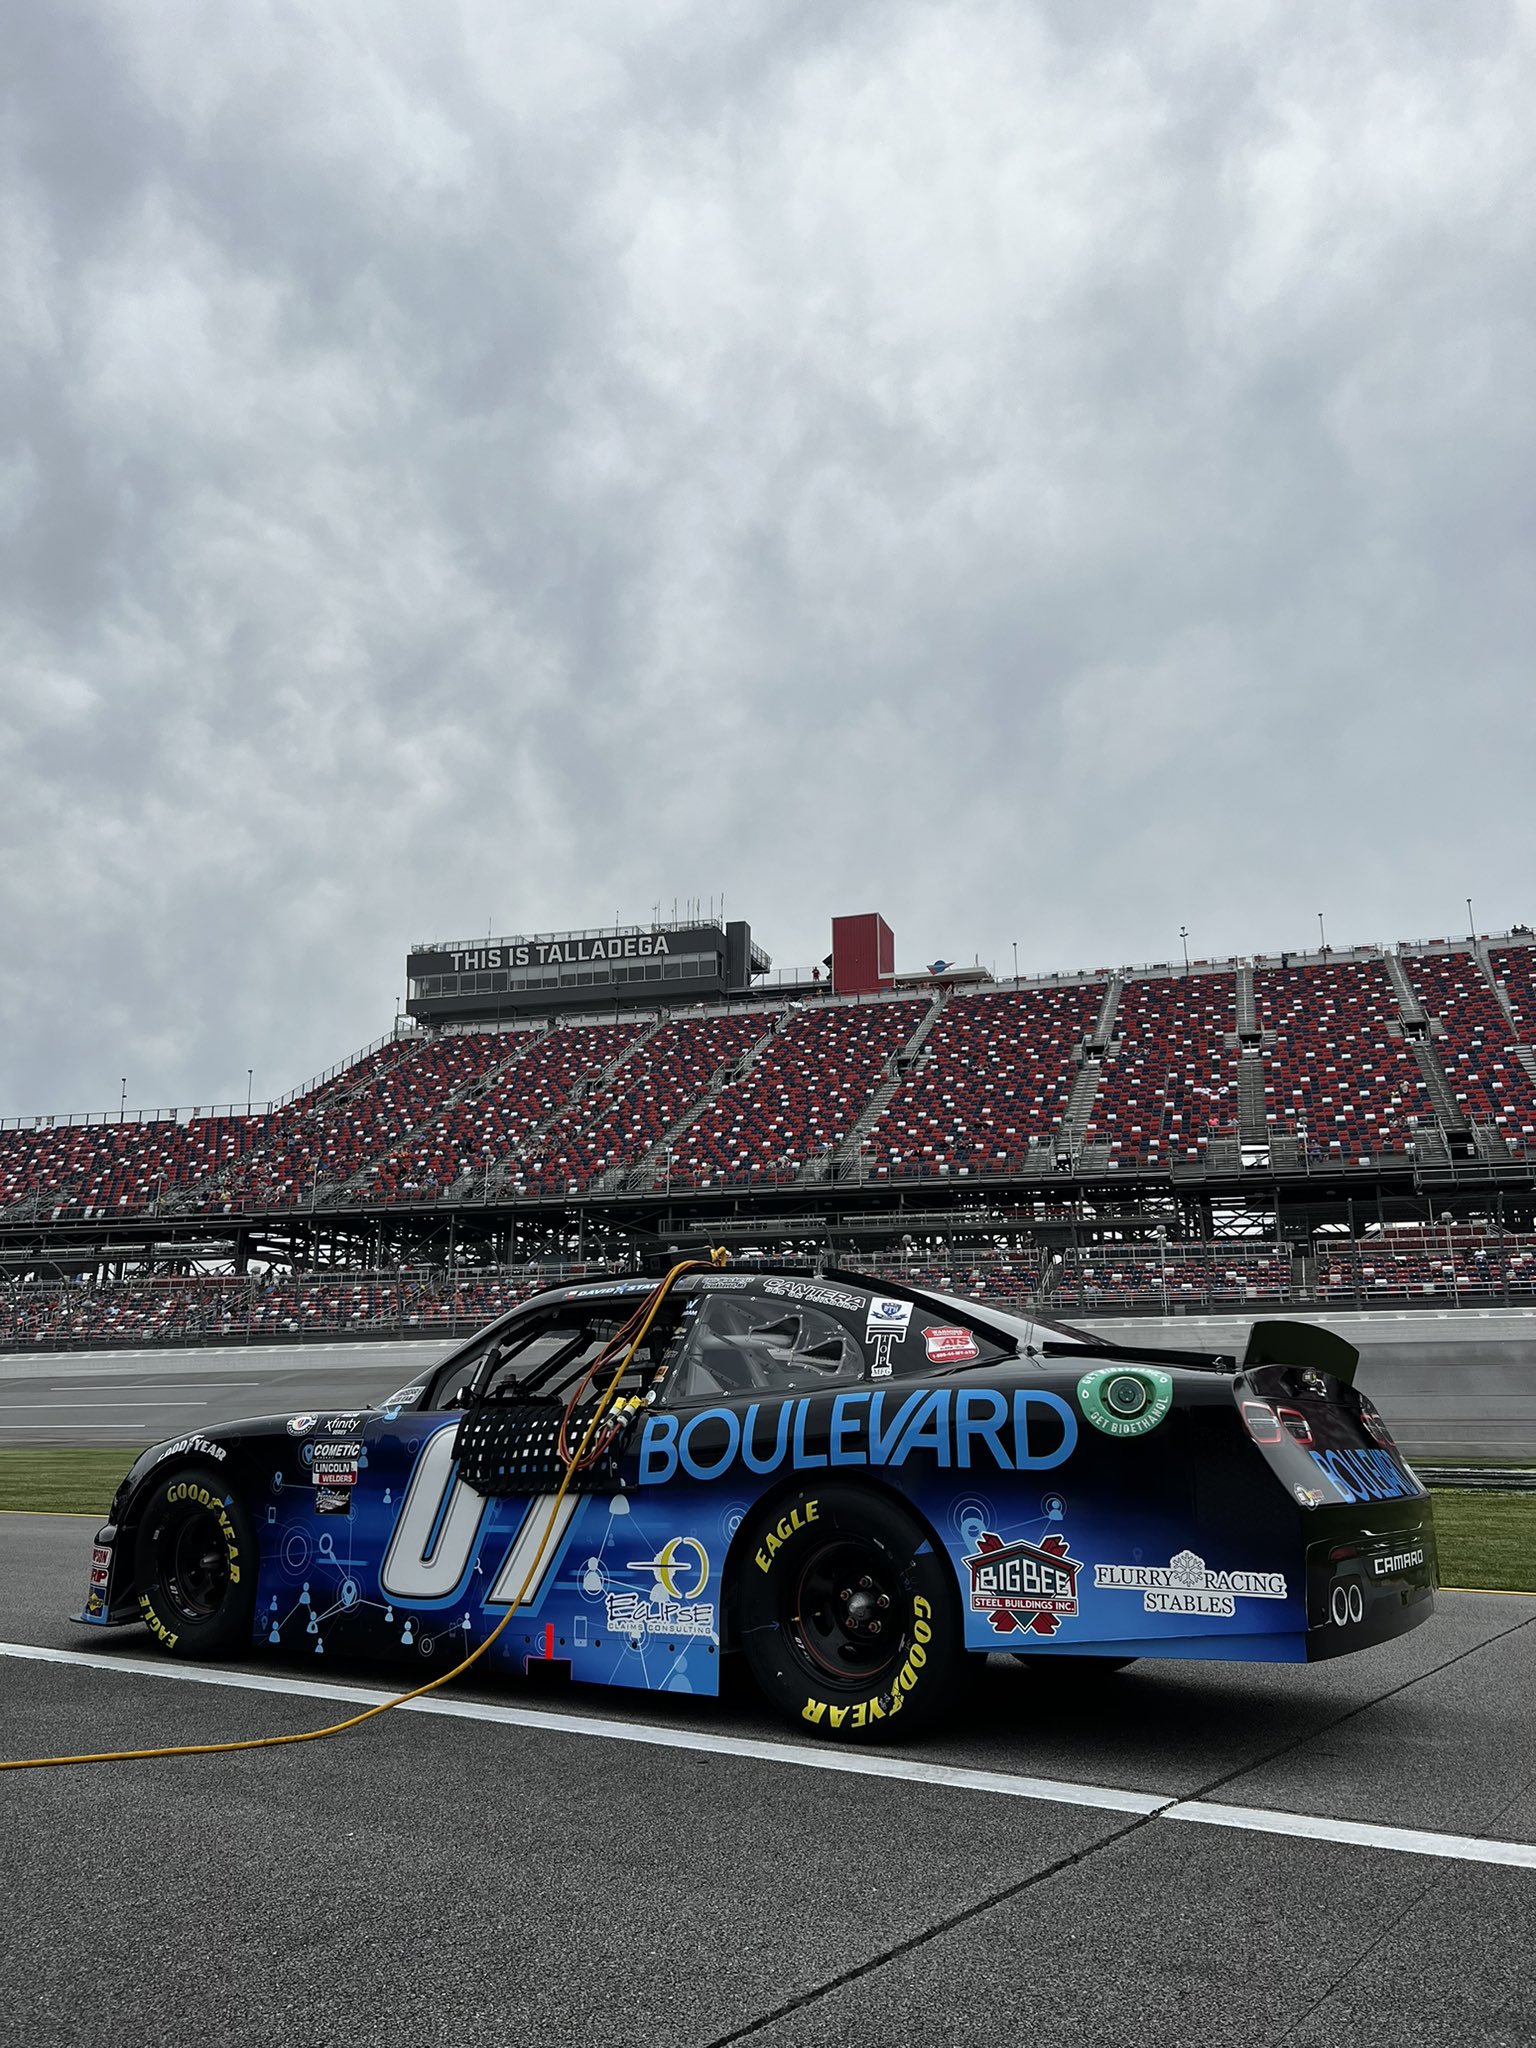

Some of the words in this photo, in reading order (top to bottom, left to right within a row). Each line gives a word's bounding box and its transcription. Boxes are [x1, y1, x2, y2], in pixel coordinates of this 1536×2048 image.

[450, 949, 501, 971] THIS
[508, 946, 530, 967] IS
[535, 935, 670, 964] TALLADEGA
[577, 1287, 614, 1297] DAVID
[763, 1278, 867, 1309] CANTERA
[880, 1334, 890, 1366] TOP
[940, 1337, 971, 1347] ATS
[873, 1367, 891, 1376] MFG
[324, 1417, 361, 1433] xfinity
[1090, 1411, 1110, 1429] GET
[1110, 1395, 1169, 1434] BIOETHANOL
[156, 1434, 227, 1462] GOODYEAR
[314, 1442, 360, 1457] COMETIC
[638, 1389, 1079, 1486] BOULEVARD
[315, 1462, 350, 1474] LINCOLN
[321, 1474, 353, 1483] WELDERS
[167, 1482, 241, 1584] GOODYEAR
[755, 1499, 820, 1574] EAGLE
[1373, 1549, 1424, 1575] CAMARO
[979, 1558, 1070, 1595] BIGBEE
[1096, 1566, 1174, 1587] FLURRY
[1204, 1572, 1284, 1593] RACING
[975, 1597, 1003, 1607] STEEL
[1004, 1599, 1053, 1610] BUILDINGS
[1055, 1601, 1075, 1612] INC.
[1146, 1592, 1234, 1614] STABLES
[138, 1594, 179, 1649] EAGLE
[608, 1622, 644, 1632] CLAIMS
[648, 1624, 712, 1635] CONSULTING
[801, 1594, 932, 1728] GOODYEAR
